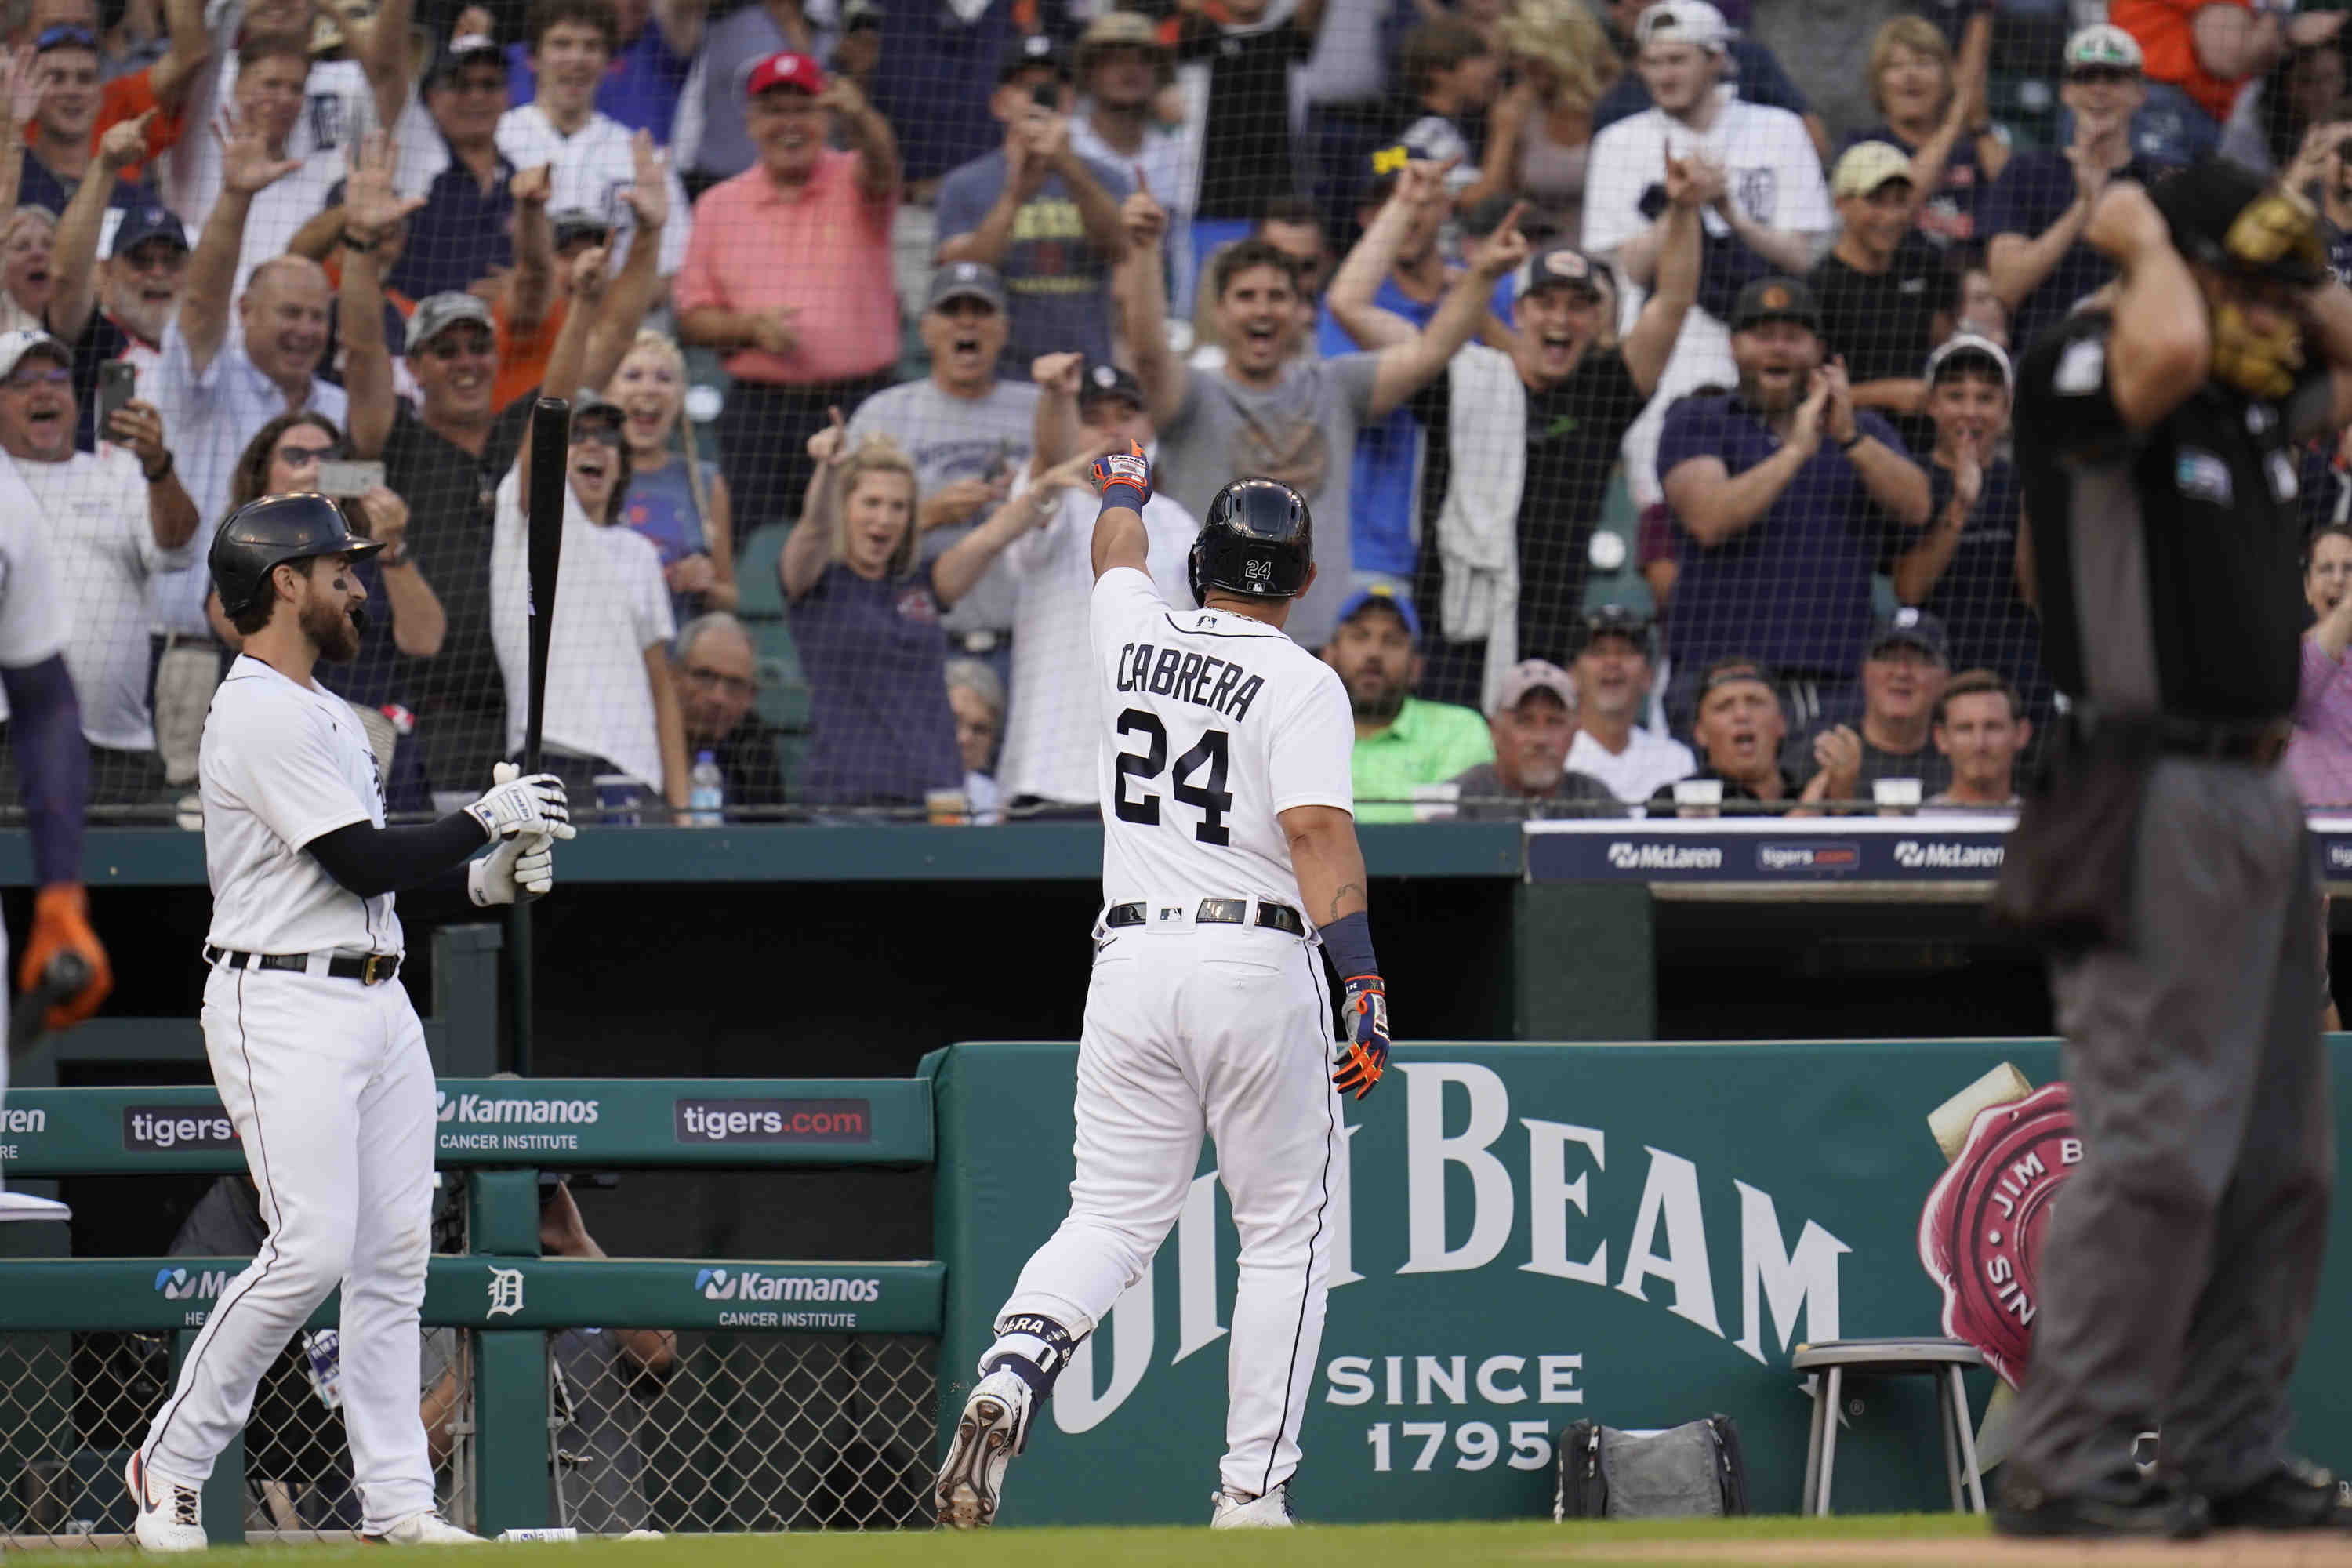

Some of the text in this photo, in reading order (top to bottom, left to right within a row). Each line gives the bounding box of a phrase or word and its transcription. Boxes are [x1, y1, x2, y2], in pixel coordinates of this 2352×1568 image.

[1245, 559, 1272, 581] 24
[1116, 642, 1265, 724] CABRERA
[1115, 707, 1234, 848] 24
[1639, 844, 1722, 868] McLaren
[1762, 847, 1855, 869] tigers.com
[459, 1094, 599, 1123] Karmanos
[684, 1106, 862, 1140] tigers.com
[439, 1135, 578, 1149] CANCER INSTITUTE
[1994, 1152, 2045, 1218] JIM
[1392, 1062, 1853, 1430] BEAM
[739, 1272, 880, 1302] Karmanos
[719, 1312, 856, 1327] CANCER INSTITUTE
[1325, 1353, 1584, 1406] SINCE
[1367, 1419, 1552, 1471] 1795
